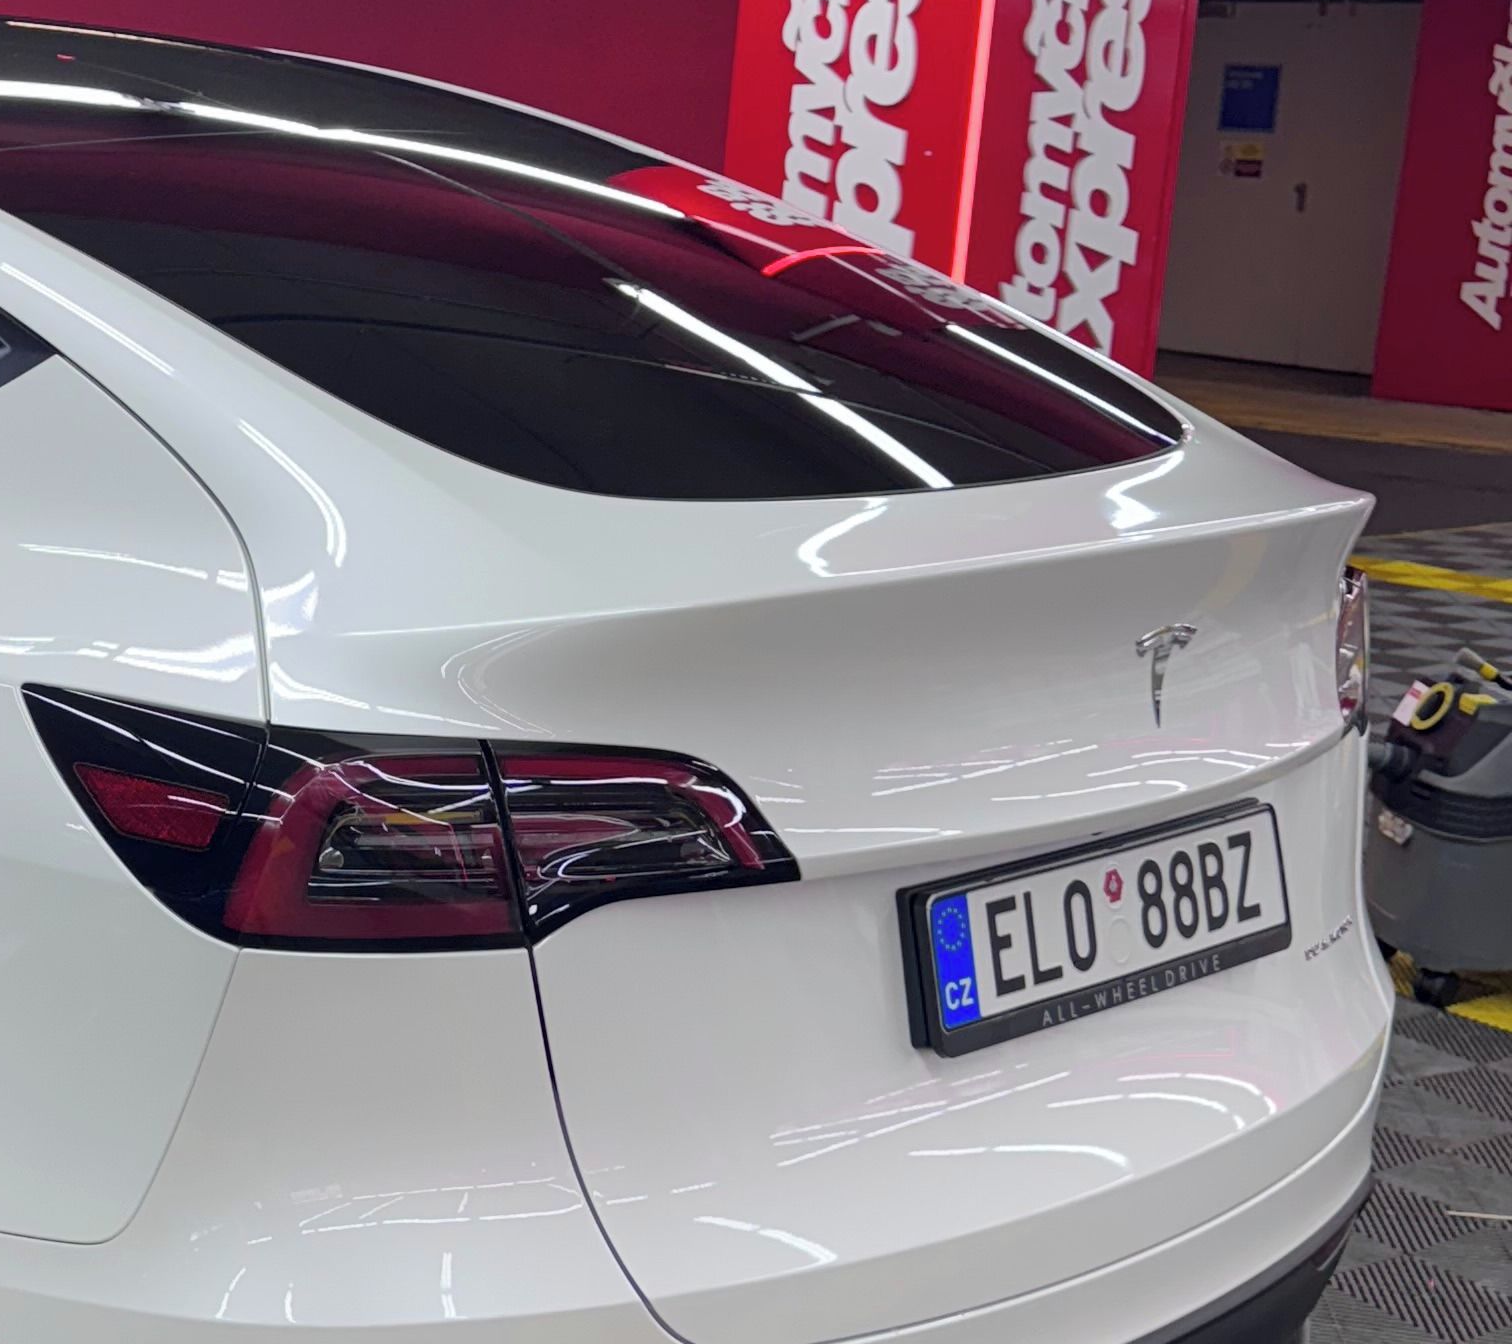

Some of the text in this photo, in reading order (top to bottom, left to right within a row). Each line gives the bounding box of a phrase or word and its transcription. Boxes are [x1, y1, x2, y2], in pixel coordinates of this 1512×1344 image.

[1138, 831, 1261, 949] 88BZ
[945, 977, 974, 1010] CZ
[1042, 954, 1221, 1026] ALL-WHEEL DRIVE
